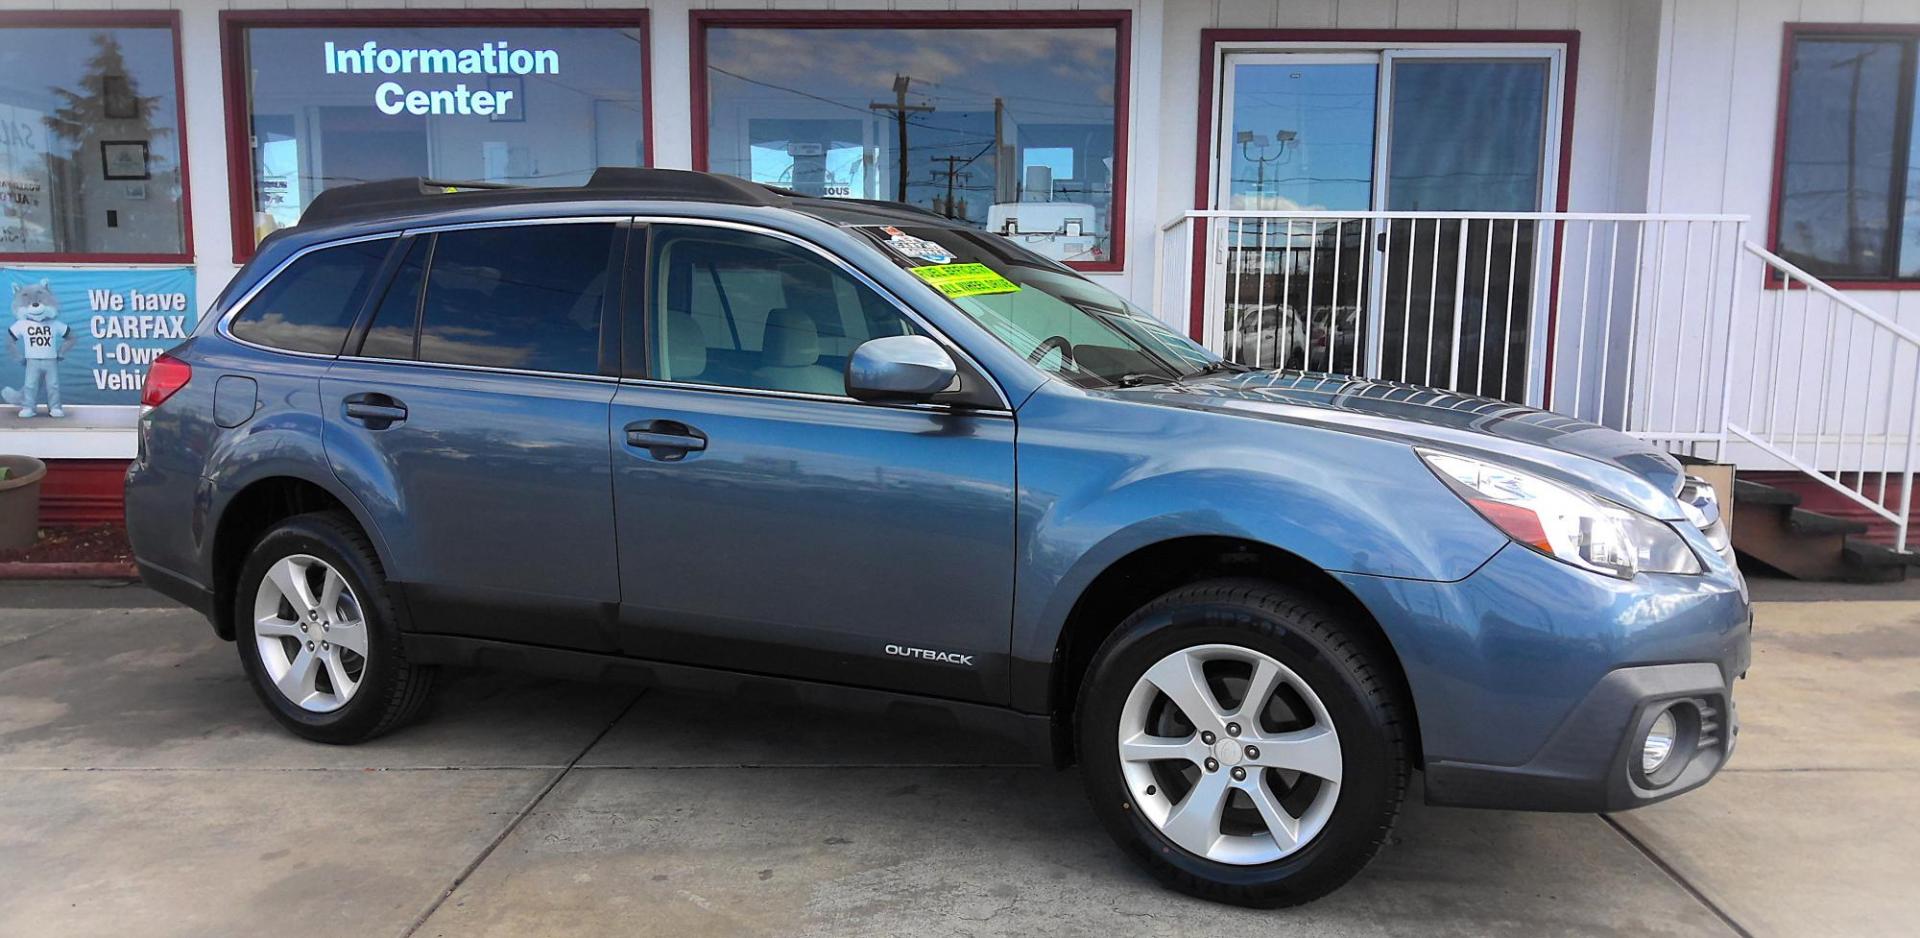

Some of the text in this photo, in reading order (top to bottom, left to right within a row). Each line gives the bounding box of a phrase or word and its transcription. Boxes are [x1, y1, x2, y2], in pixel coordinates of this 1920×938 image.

[325, 41, 560, 74] Information
[375, 81, 513, 115] Center
[88, 289, 186, 311] We have
[27, 325, 52, 337] CAR
[90, 315, 187, 339] CARFAX
[30, 336, 52, 347] FOX
[885, 644, 974, 666] OUTBACK
